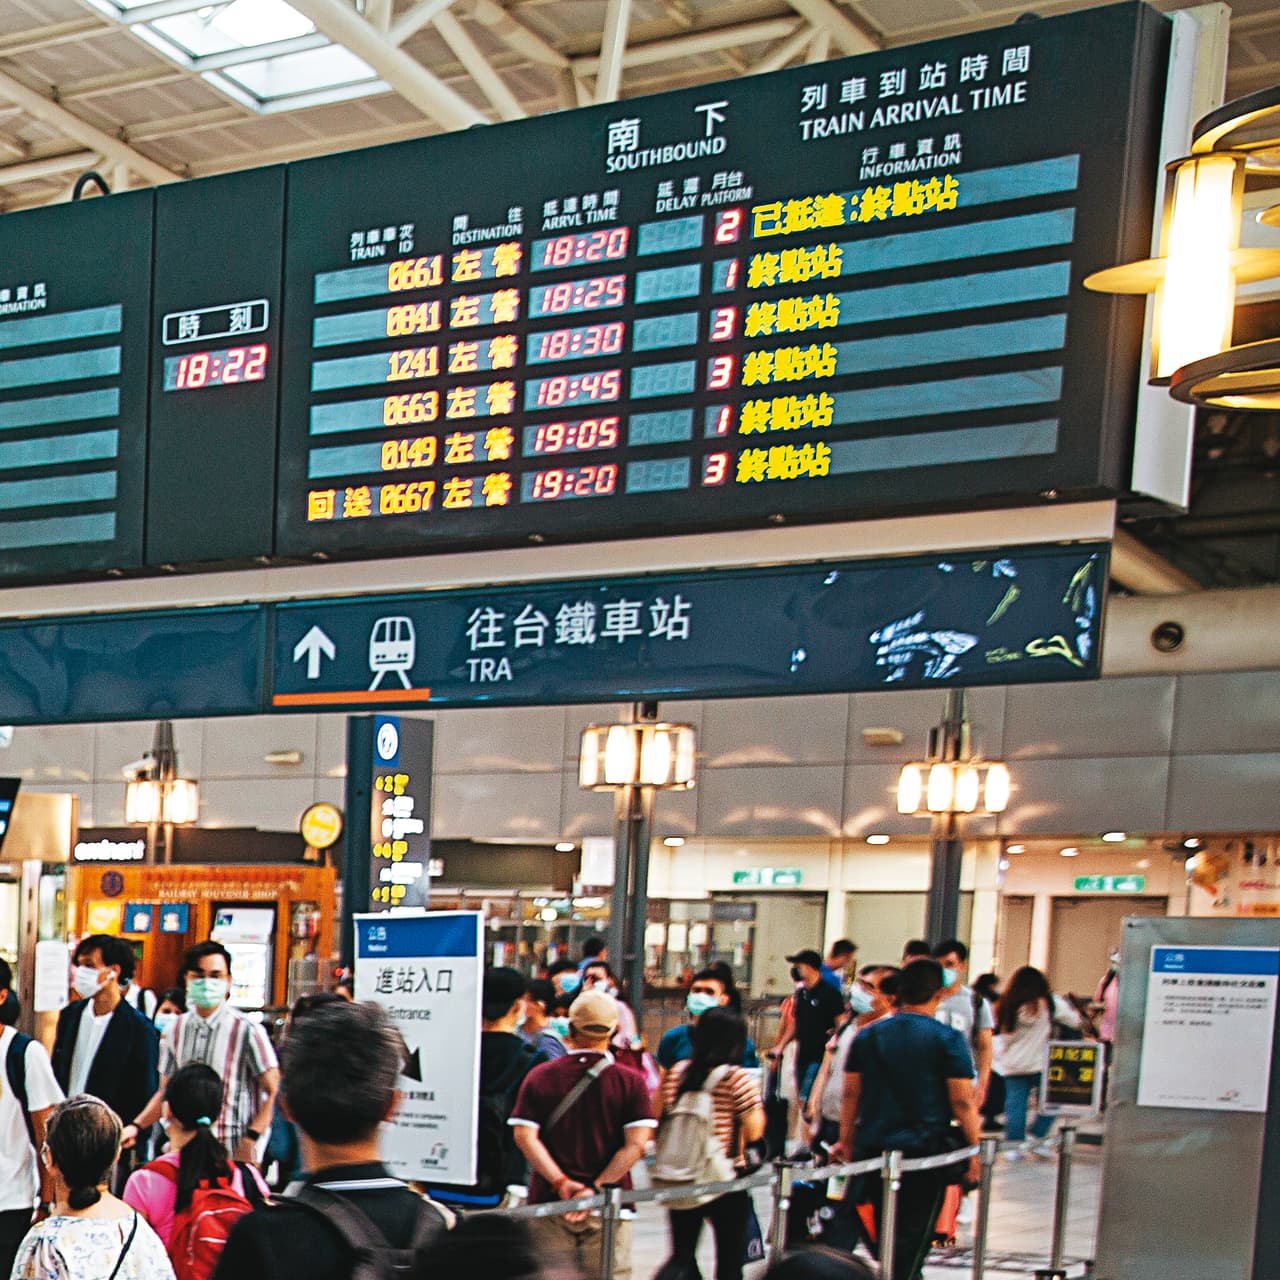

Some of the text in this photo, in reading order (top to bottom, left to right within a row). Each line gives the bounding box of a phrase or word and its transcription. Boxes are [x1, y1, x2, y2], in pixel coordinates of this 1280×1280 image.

[800, 45, 1031, 113] 列車到站時間
[799, 81, 1027, 141] TRAIN ARRIVAL TIME
[606, 136, 727, 173] SOUTHBOUND
[859, 151, 961, 180] INFORMATION
[656, 186, 753, 213] DELAY PLATFORM
[712, 171, 744, 190] 月台
[452, 223, 523, 246] DESTINATION
[542, 206, 617, 231] ARRVL TIME
[350, 240, 414, 261] TRAIN ID
[388, 255, 443, 291] 0661
[451, 241, 523, 282] 左營
[543, 226, 630, 267] 18:20
[714, 208, 742, 244] 2
[386, 243, 843, 337] 0841 左營 18:25 1 終點站
[178, 307, 252, 340] 時刻
[386, 292, 840, 382] 1241 左營 18:30 3 終點站
[175, 343, 268, 390] 18:22
[383, 342, 838, 426] 0663 左營 18:45 3 終點站
[381, 392, 834, 471] 0149 左營 19:05 1 終點站
[307, 441, 831, 522] 回送 0667 左營 19:20 3 終點站
[465, 595, 691, 650] 往台鐵車站
[466, 657, 513, 683] TRA
[375, 966, 453, 994] 進站入口
